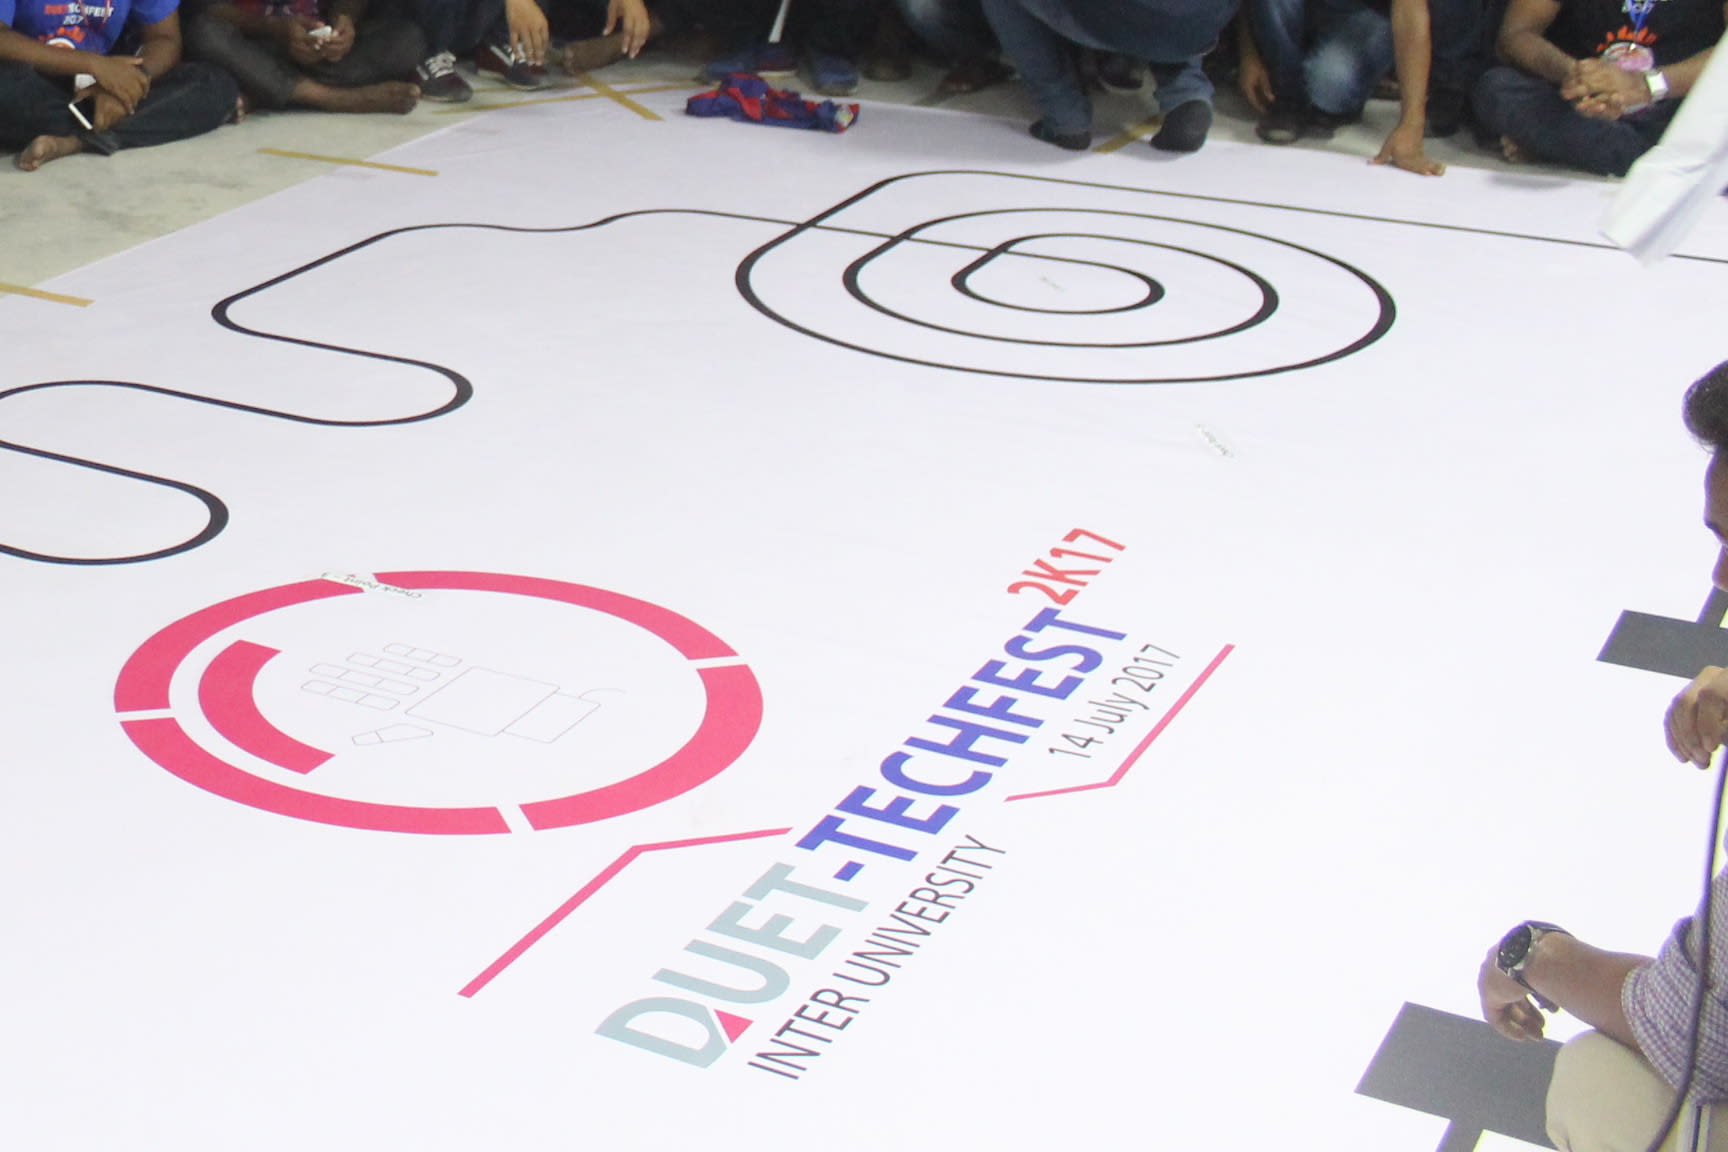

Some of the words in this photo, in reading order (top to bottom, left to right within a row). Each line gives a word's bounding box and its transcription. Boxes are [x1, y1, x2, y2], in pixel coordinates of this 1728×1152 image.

[1007, 528, 1127, 606] 2K17
[1111, 644, 1181, 692] 2017
[1074, 692, 1150, 734] July
[1048, 734, 1104, 758] 14
[747, 988, 871, 1080] INTER
[832, 834, 1007, 986] UNIVERSITY
